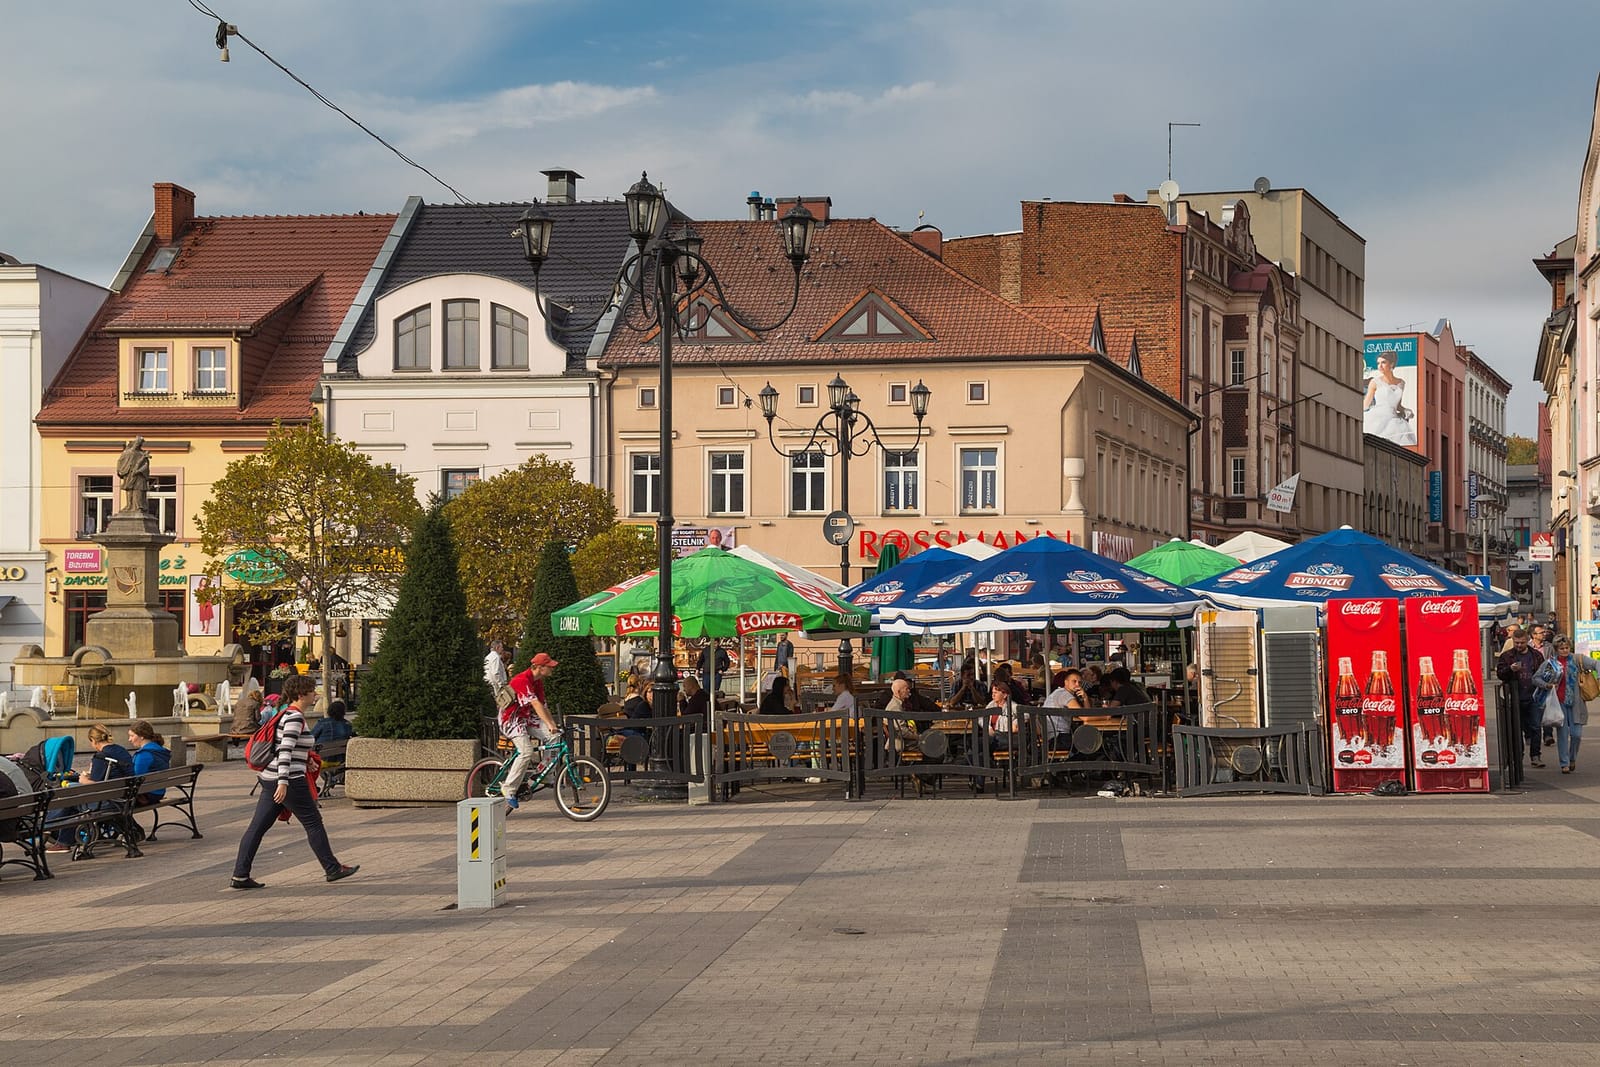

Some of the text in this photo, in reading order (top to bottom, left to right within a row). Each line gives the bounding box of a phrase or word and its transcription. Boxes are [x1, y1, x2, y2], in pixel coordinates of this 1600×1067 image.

[1366, 341, 1413, 353] SARAH
[1271, 493, 1282, 502] 90
[68, 561, 98, 569] BIŻUTERIA
[1292, 577, 1347, 586] RYBNICKI
[1388, 578, 1439, 587] RYBNICKI
[977, 584, 1027, 593] RYBNICKI
[856, 594, 897, 603] RYBNICKI
[1341, 601, 1383, 615] Coca-Cola
[1421, 600, 1463, 614] Coca-Cola
[560, 616, 580, 631] ŁOMŻA
[620, 615, 678, 630] ŁOMA
[740, 613, 798, 631] ŁOMŻA
[1363, 697, 1395, 712] Coca-Cola
[1445, 697, 1478, 712] Coca-Cola
